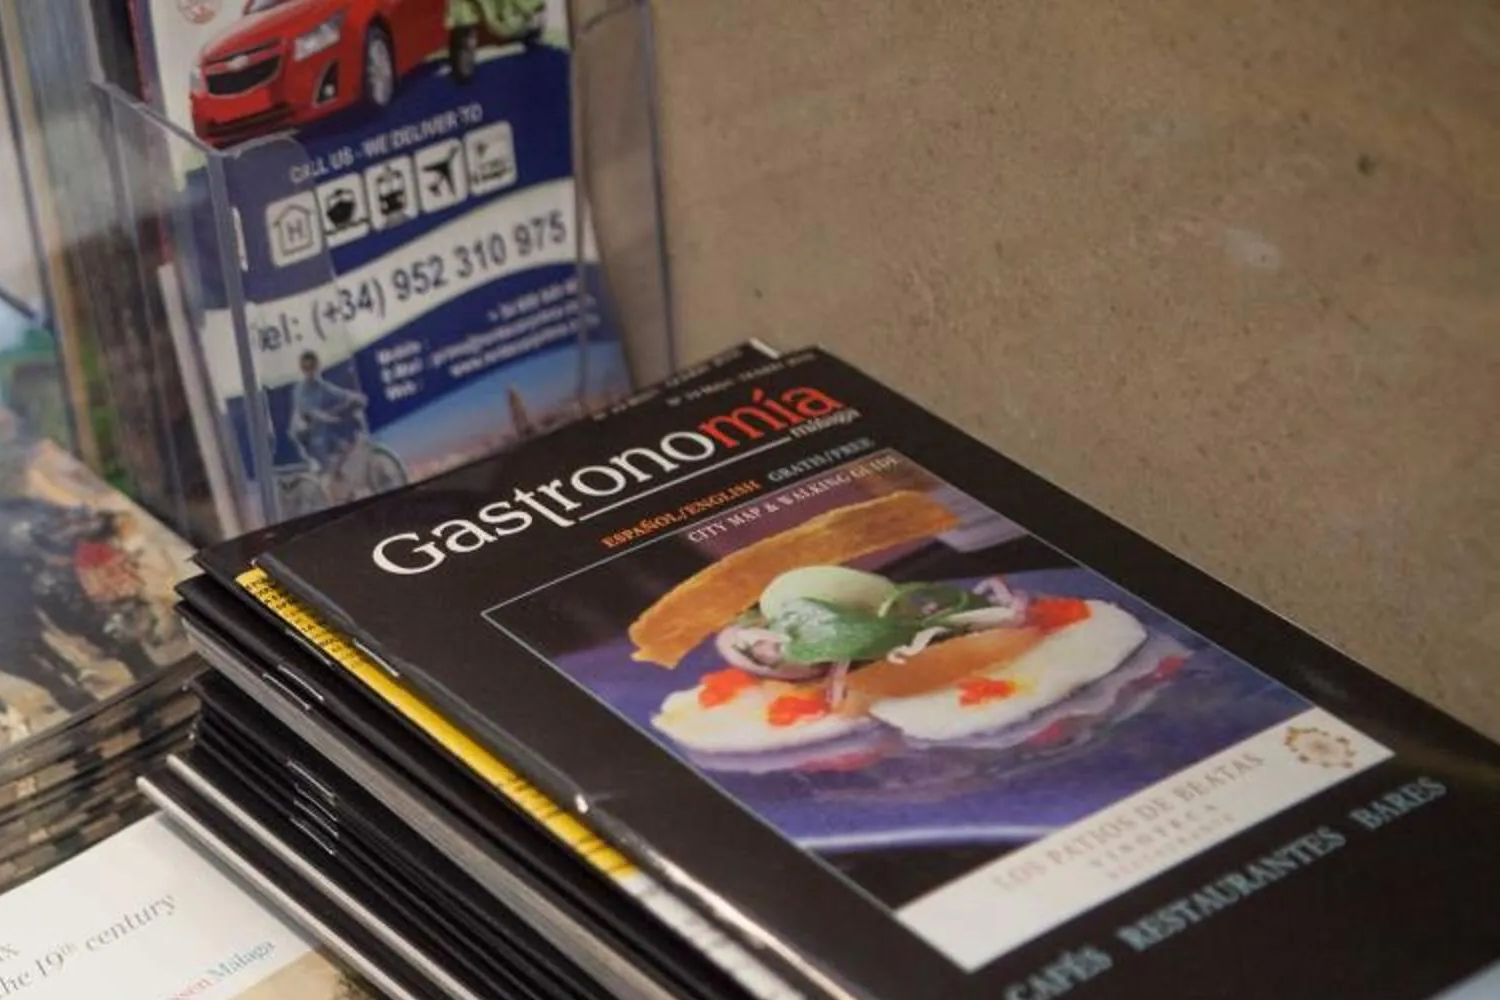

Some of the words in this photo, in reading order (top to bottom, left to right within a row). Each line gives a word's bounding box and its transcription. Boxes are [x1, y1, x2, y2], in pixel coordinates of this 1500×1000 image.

[392, 110, 458, 148] DELIVER
[458, 102, 485, 124] TO
[311, 278, 386, 341] (+34)
[393, 254, 448, 301] 952
[456, 233, 506, 281] 310
[515, 210, 567, 258] 975
[372, 384, 850, 576] Gastronomía
[601, 478, 763, 549] ESPAÑOL/ENGLISH
[687, 522, 728, 545] CITY
[727, 507, 763, 530] MAP
[1047, 815, 1136, 866] PATIOS
[1133, 796, 1176, 823] DE
[1172, 751, 1265, 803] BEATAS
[1116, 824, 1349, 953] RESTAURANTES
[1349, 774, 1449, 833] BARES
[84, 892, 179, 954] century
